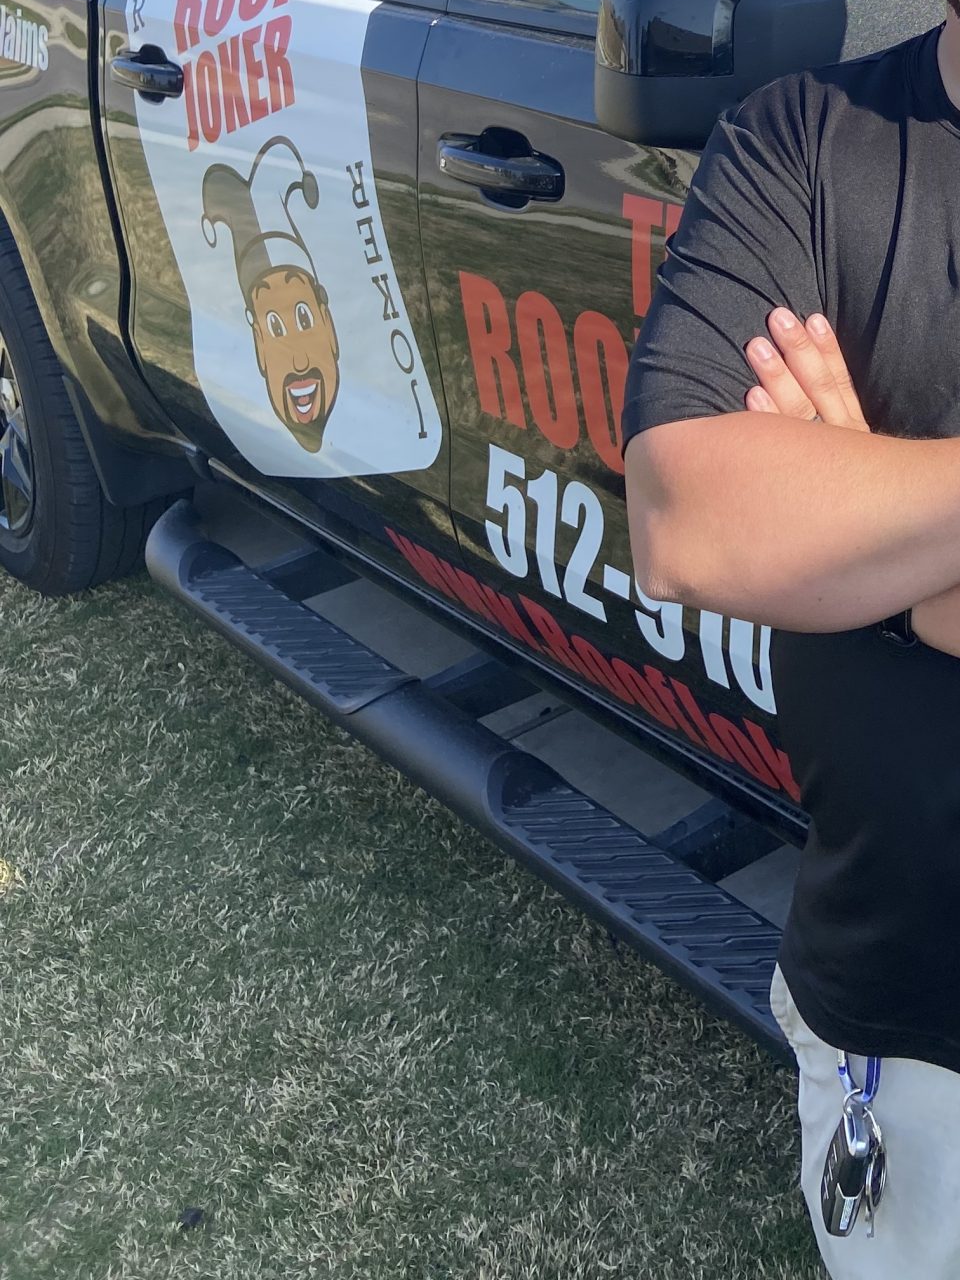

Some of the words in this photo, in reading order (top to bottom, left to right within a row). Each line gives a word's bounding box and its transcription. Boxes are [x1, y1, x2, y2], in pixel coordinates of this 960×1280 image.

[182, 15, 295, 152] JOKER
[346, 160, 428, 439] JOKER
[459, 270, 642, 476] ROO
